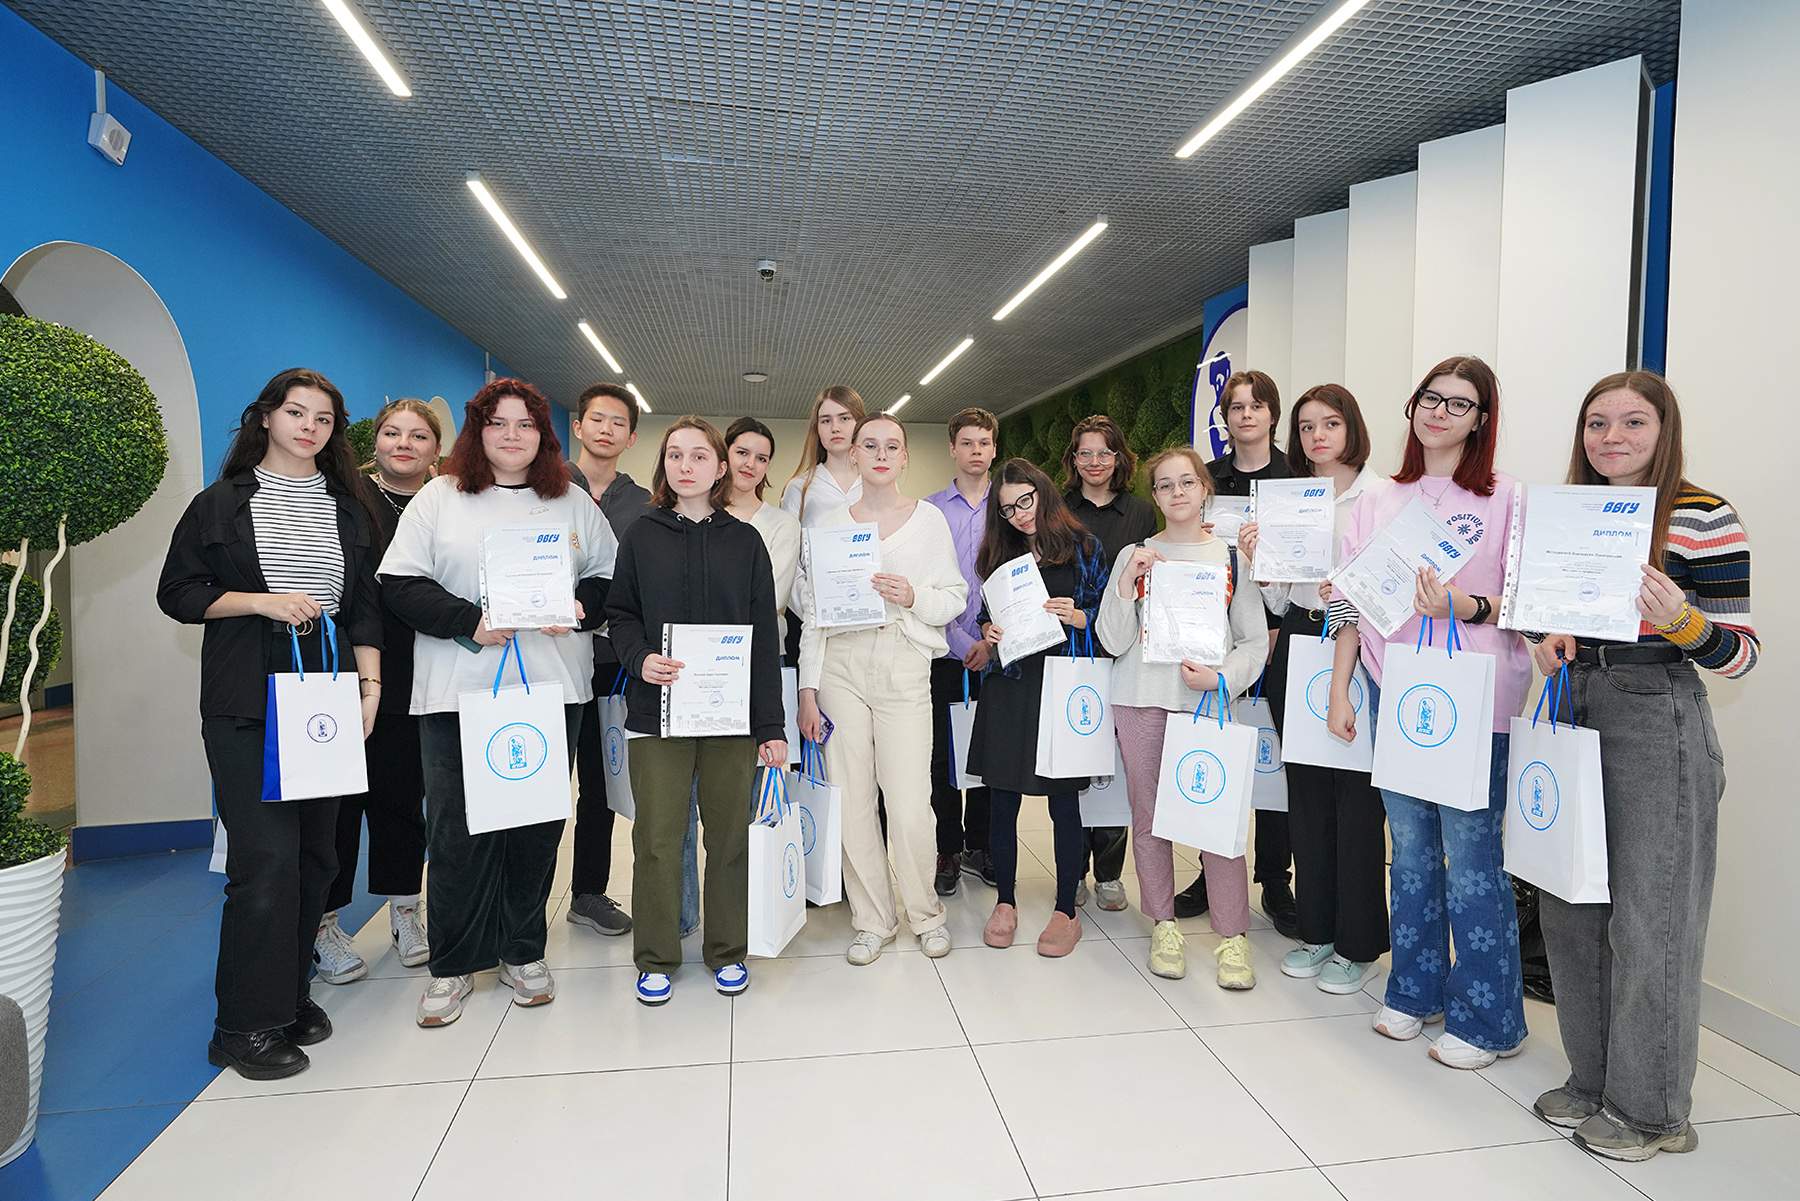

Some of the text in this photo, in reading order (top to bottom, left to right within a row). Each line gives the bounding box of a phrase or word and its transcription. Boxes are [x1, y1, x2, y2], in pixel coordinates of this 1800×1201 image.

[1602, 501, 1641, 514] ВВГУ
[1446, 513, 1484, 545] POSITIVE VIBR
[1592, 529, 1633, 538] ДИПЛОМ
[537, 533, 560, 543] ВВГУ
[852, 533, 871, 542] ВВГУ
[1438, 540, 1461, 559] ВВГУ
[721, 635, 743, 644] ВВГУ
